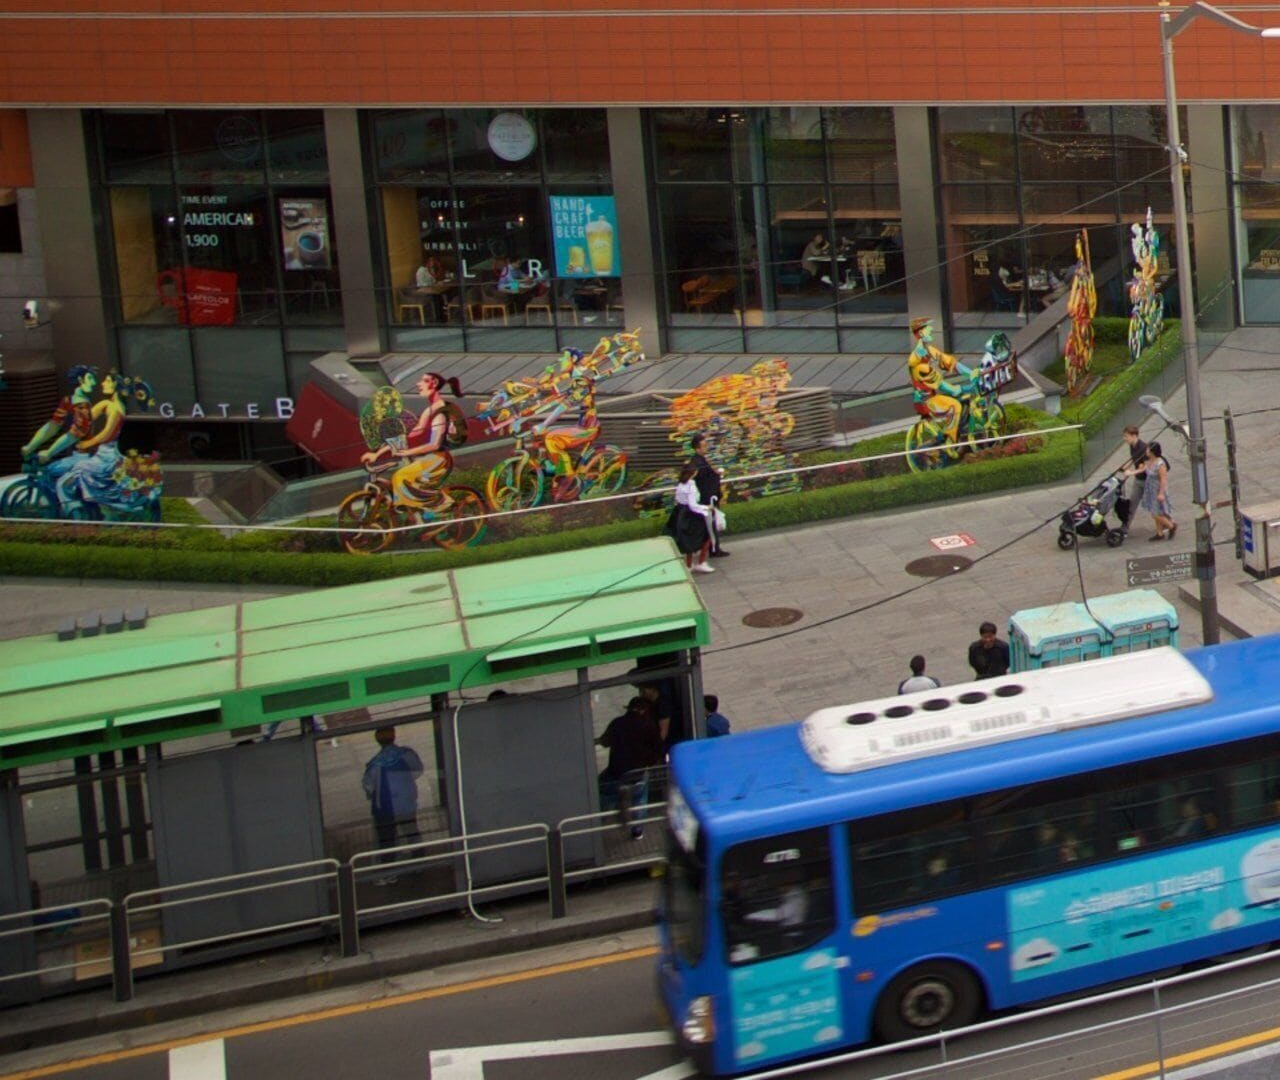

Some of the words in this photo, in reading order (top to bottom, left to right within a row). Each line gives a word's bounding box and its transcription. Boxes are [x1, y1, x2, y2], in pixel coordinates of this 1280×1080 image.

[202, 196, 228, 204] EVENT
[421, 221, 468, 229] BKERY
[556, 226, 585, 238] BEER
[159, 403, 260, 419] GATE
